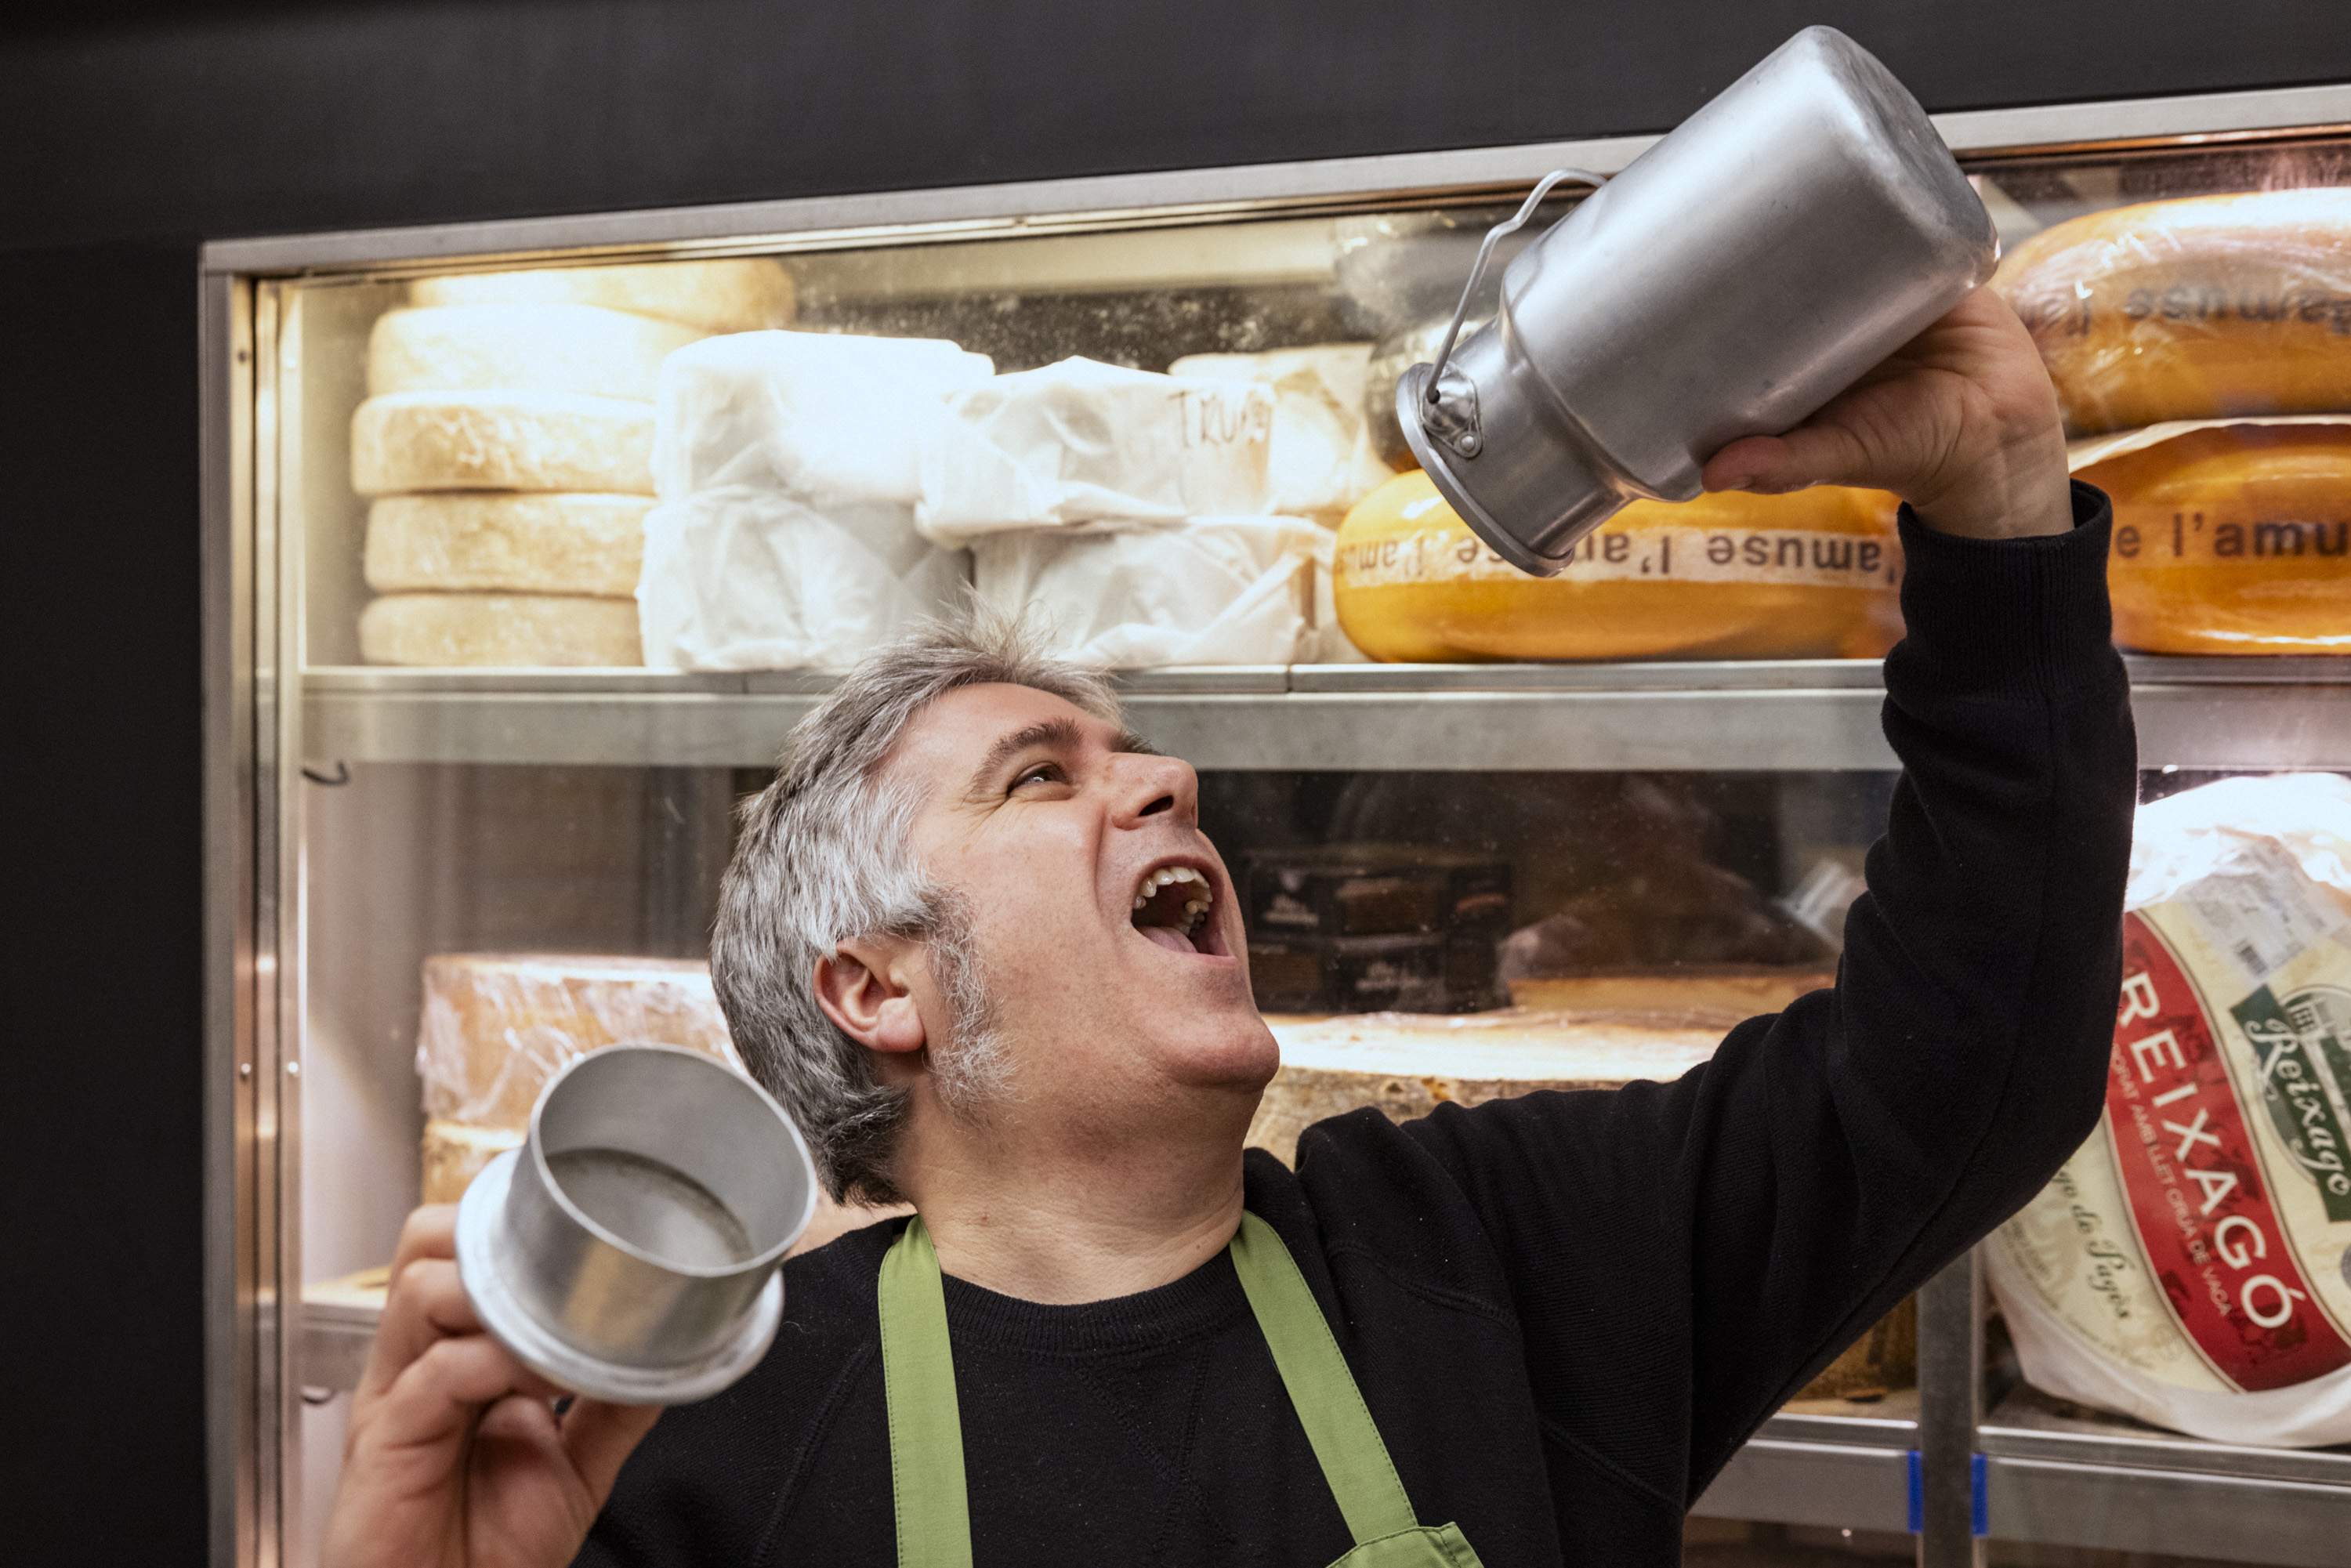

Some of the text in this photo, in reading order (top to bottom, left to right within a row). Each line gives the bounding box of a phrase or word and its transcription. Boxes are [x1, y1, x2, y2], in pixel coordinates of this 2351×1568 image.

[1707, 534, 1896, 585] 'amuse
[2119, 971, 2306, 1329] REIXAGÓ
[2245, 1017, 2349, 1197] Reixago
[2189, 1239, 2211, 1266] DE
[2201, 1266, 2233, 1317] VACA
